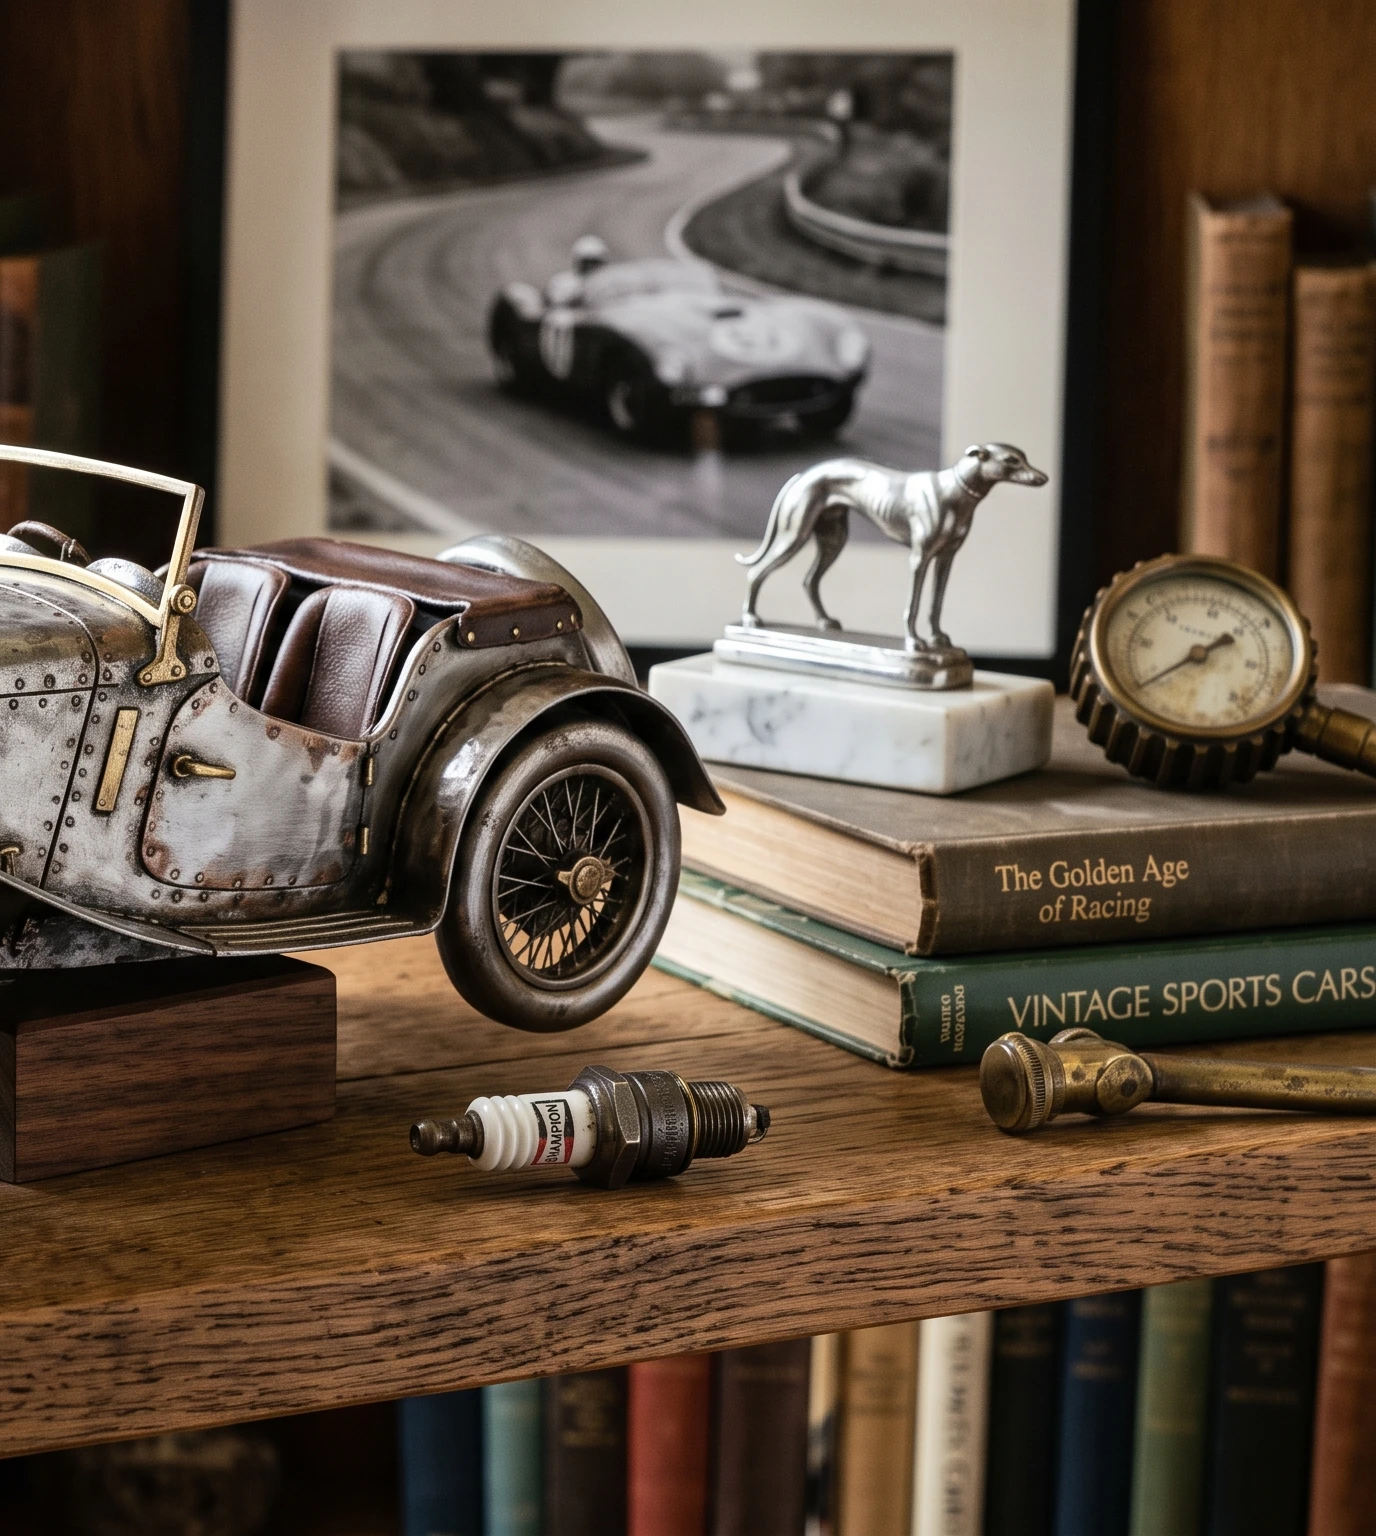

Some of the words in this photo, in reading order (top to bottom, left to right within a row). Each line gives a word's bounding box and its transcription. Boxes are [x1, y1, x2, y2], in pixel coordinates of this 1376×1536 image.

[995, 864, 1043, 892] The
[1049, 858, 1135, 888] Golden
[1142, 855, 1190, 888] Age
[1039, 895, 1066, 923] of
[1070, 892, 1152, 923] Racing
[1008, 985, 1150, 1028] VINTAGE
[1162, 973, 1282, 1016] SPORTS
[1291, 965, 1376, 1004] CARS
